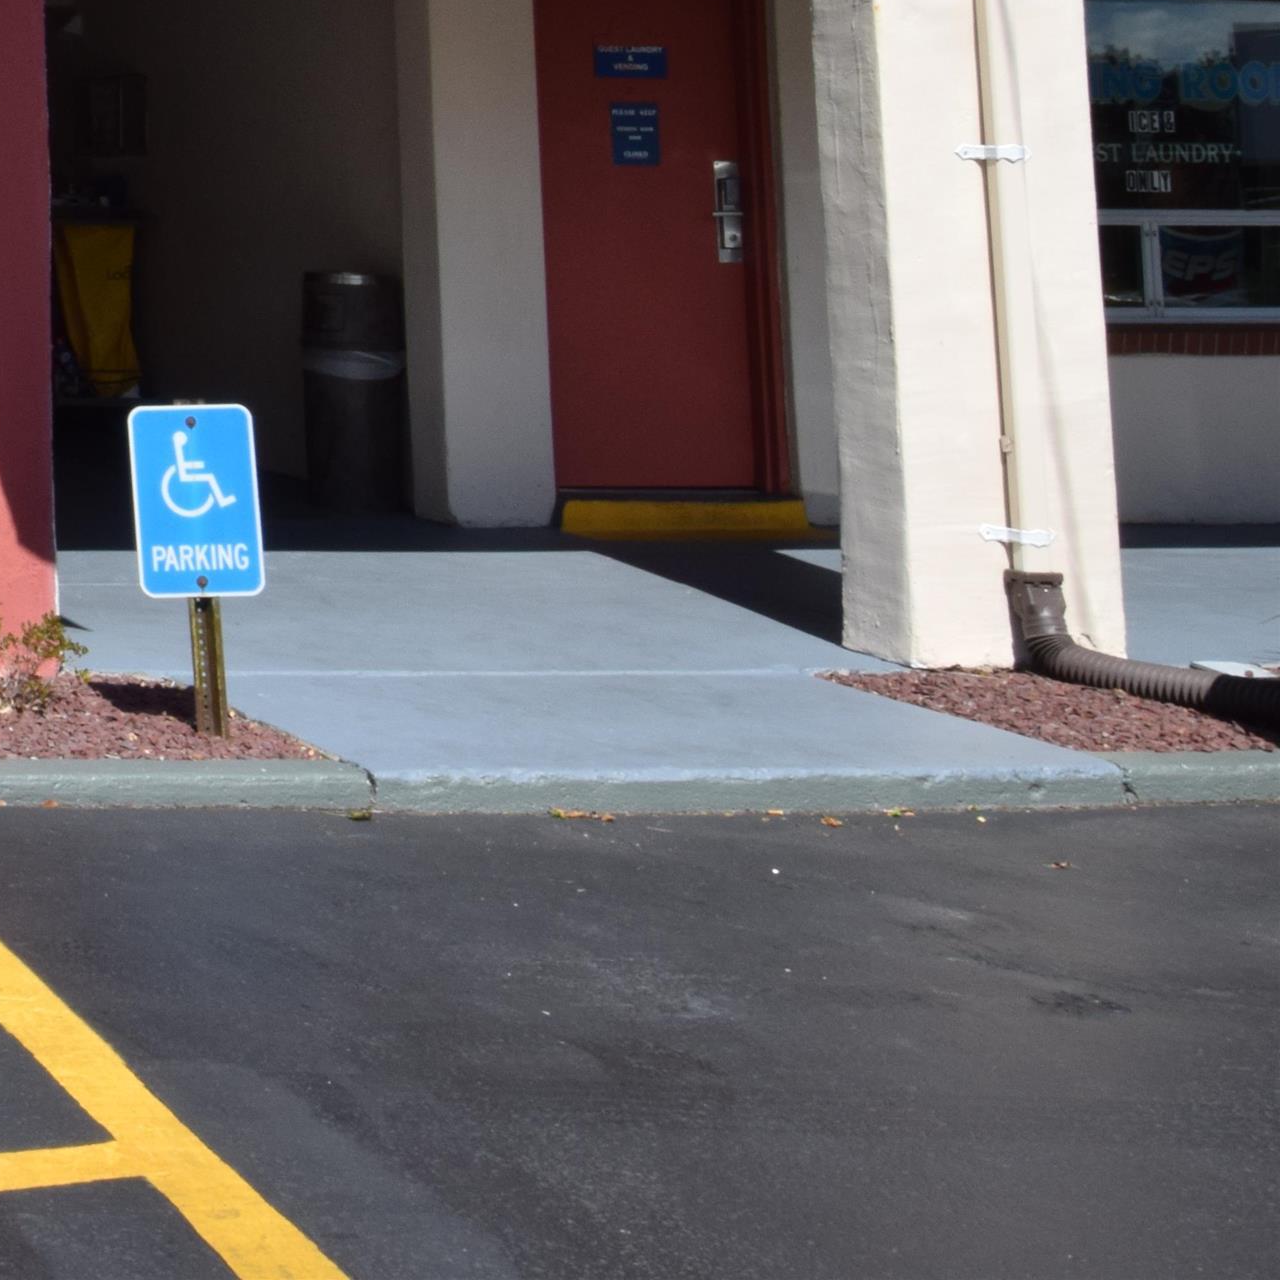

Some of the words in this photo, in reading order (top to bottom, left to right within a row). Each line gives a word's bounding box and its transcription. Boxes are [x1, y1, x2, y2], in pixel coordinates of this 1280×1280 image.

[1090, 61, 1163, 101] ING
[1128, 110, 1160, 133] ICE
[1094, 142, 1122, 163] ST
[1126, 170, 1172, 193] ONLY
[1162, 249, 1240, 281] EPS
[151, 543, 250, 572] PARKING
